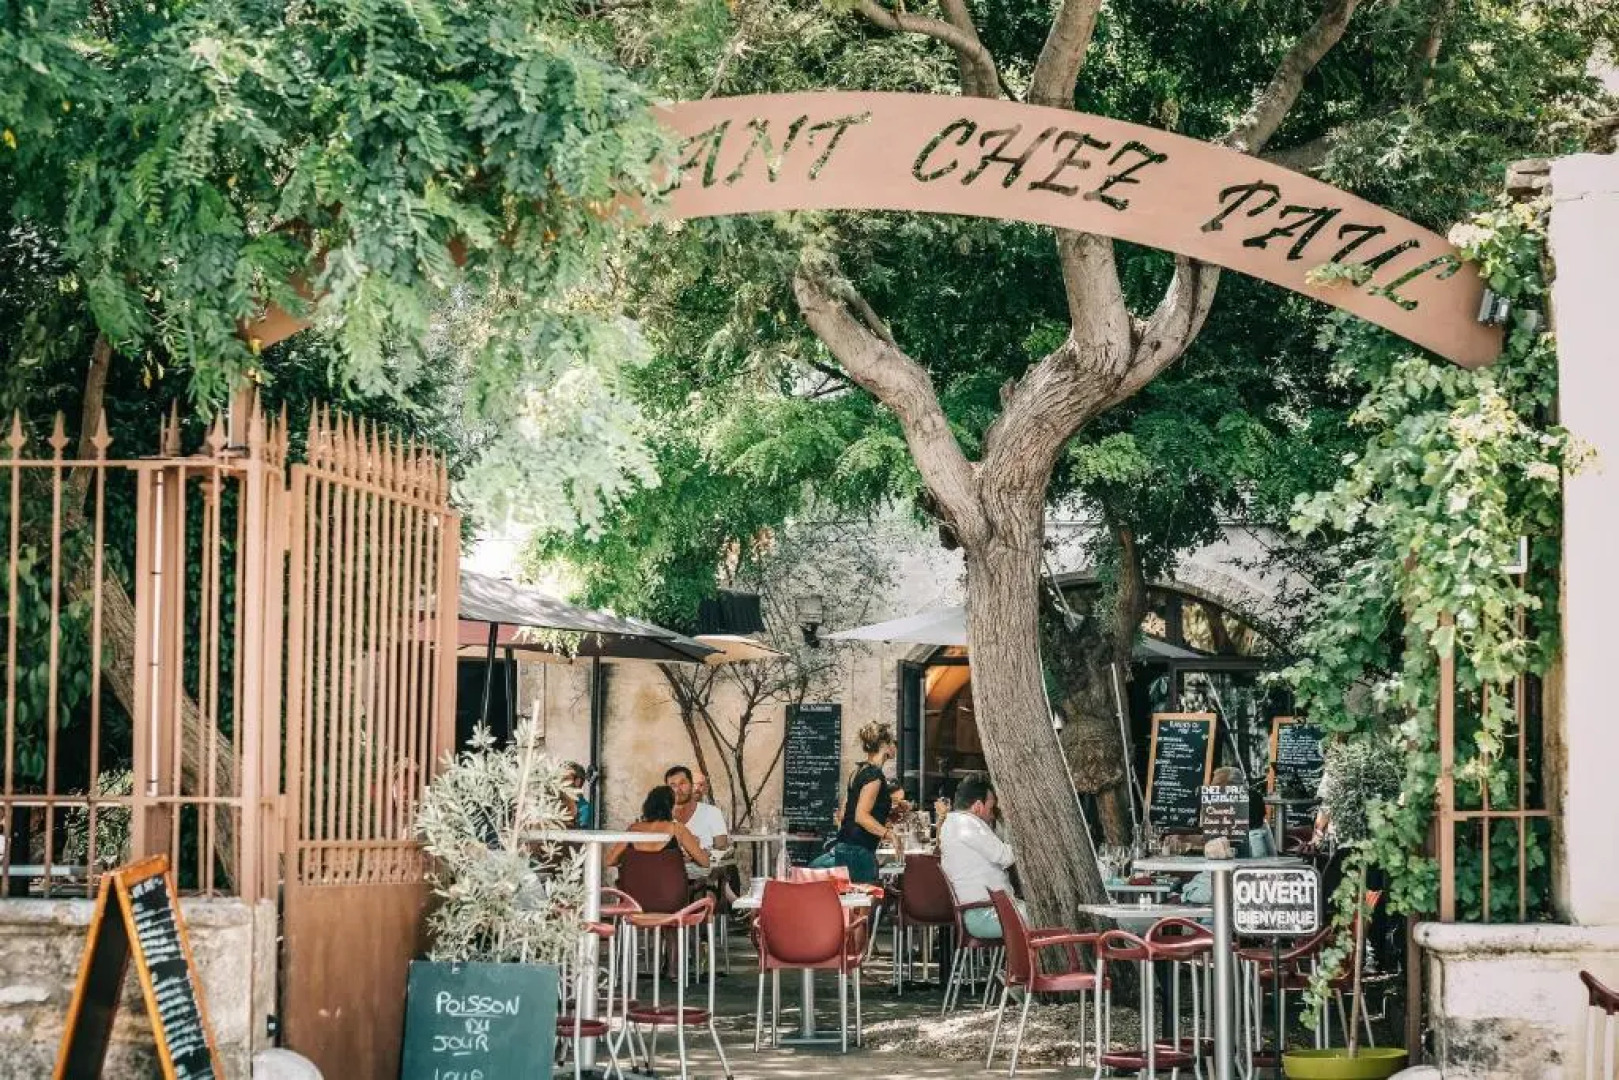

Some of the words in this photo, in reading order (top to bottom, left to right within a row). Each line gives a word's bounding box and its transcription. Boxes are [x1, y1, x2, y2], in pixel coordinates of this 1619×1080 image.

[648, 111, 872, 196] ANT
[912, 118, 1168, 211] CHEZ
[1201, 180, 1462, 311] PAUL
[1237, 879, 1315, 904] OUVERT
[1237, 910, 1315, 925] BIENVENUE
[465, 1018, 490, 1034] DU
[432, 1034, 490, 1052] JOUR
